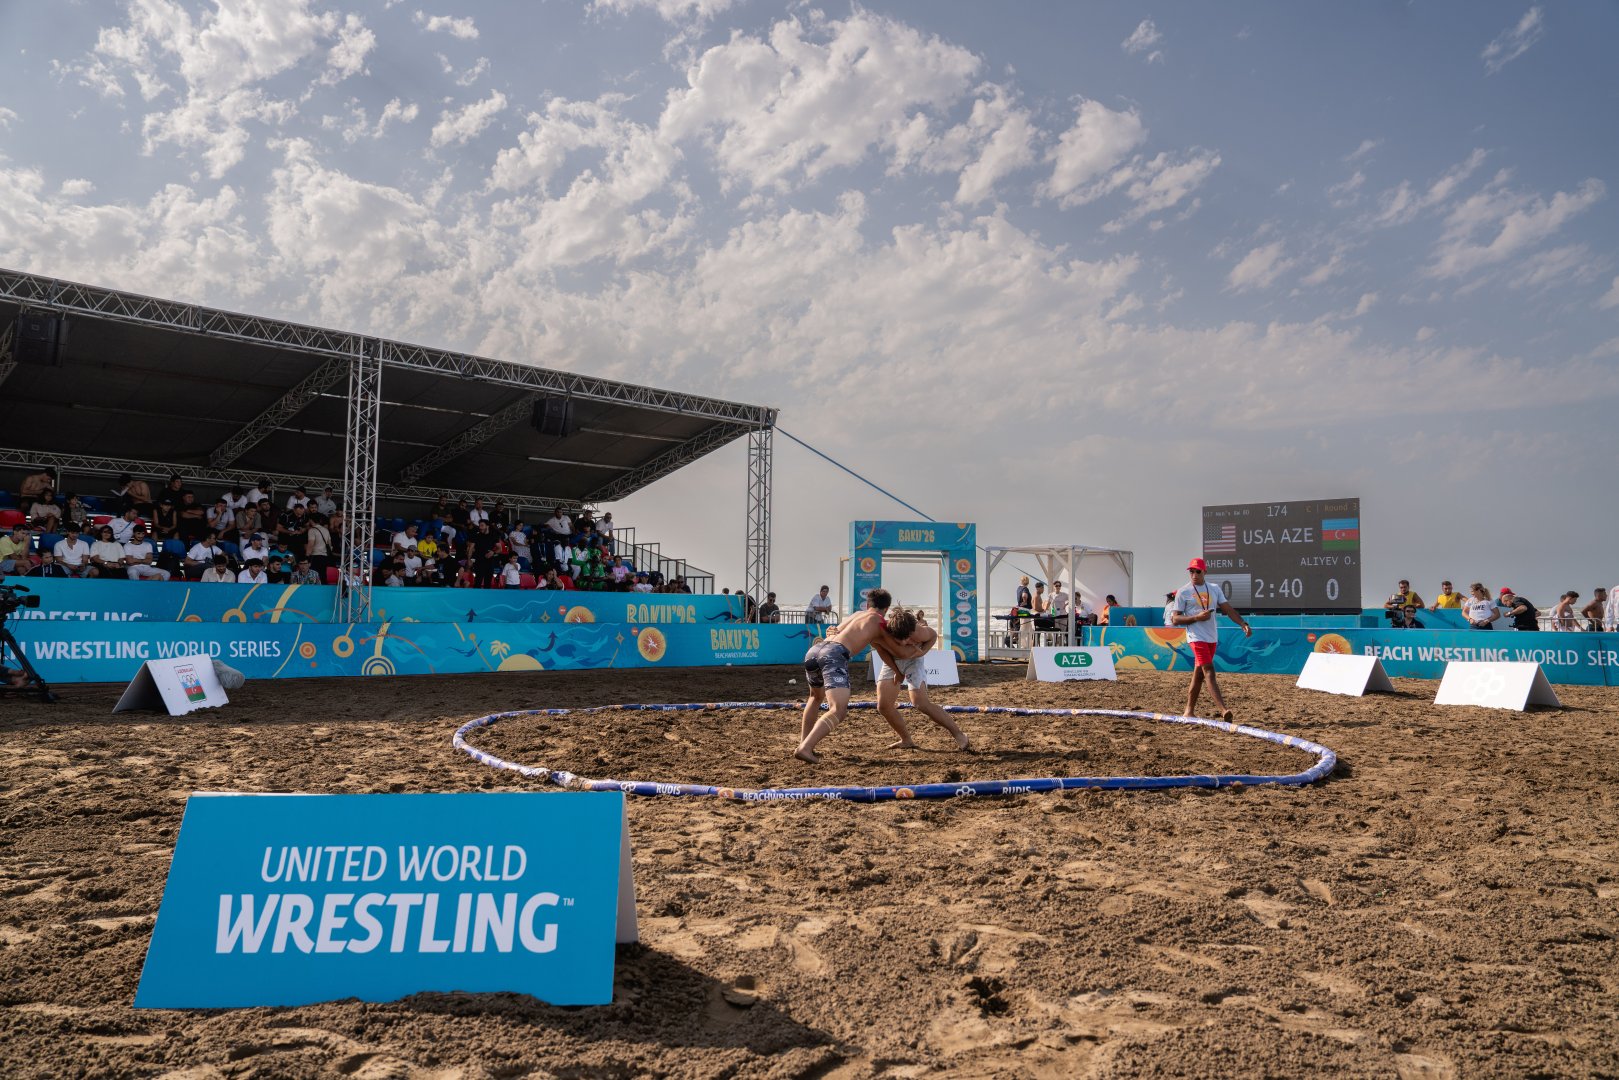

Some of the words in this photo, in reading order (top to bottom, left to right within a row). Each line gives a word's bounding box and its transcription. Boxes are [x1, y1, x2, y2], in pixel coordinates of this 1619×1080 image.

[1267, 504, 1288, 517] 174
[1325, 503, 1348, 512] Round
[898, 529, 935, 542] BAKU'26
[1243, 529, 1275, 545] USA
[1280, 527, 1314, 544] AZE
[1205, 559, 1233, 568] AHERN
[1238, 558, 1249, 568] B.
[1300, 556, 1339, 566] ALIYEV
[1344, 555, 1356, 565] O.
[1221, 580, 1233, 601] 0
[1254, 578, 1303, 598] 2:40
[1326, 578, 1339, 600] 0
[710, 628, 759, 650] BAKU'26
[34, 641, 149, 660] WRESTLING
[156, 641, 221, 658] WORLD
[229, 640, 281, 658] SERIES
[1364, 645, 1412, 661] BEACH
[1417, 647, 1508, 663] WRESTLING
[1515, 649, 1578, 665] WORLD
[1587, 649, 1619, 666] SER
[1061, 654, 1087, 665] AZE
[656, 783, 681, 796] RUDIS
[742, 792, 842, 801] BEACHWRESTLINGORG
[1002, 785, 1031, 795] RUDIS
[261, 846, 387, 883] UNITED
[399, 845, 527, 882] WORLD
[215, 892, 560, 954] WRESTLING
